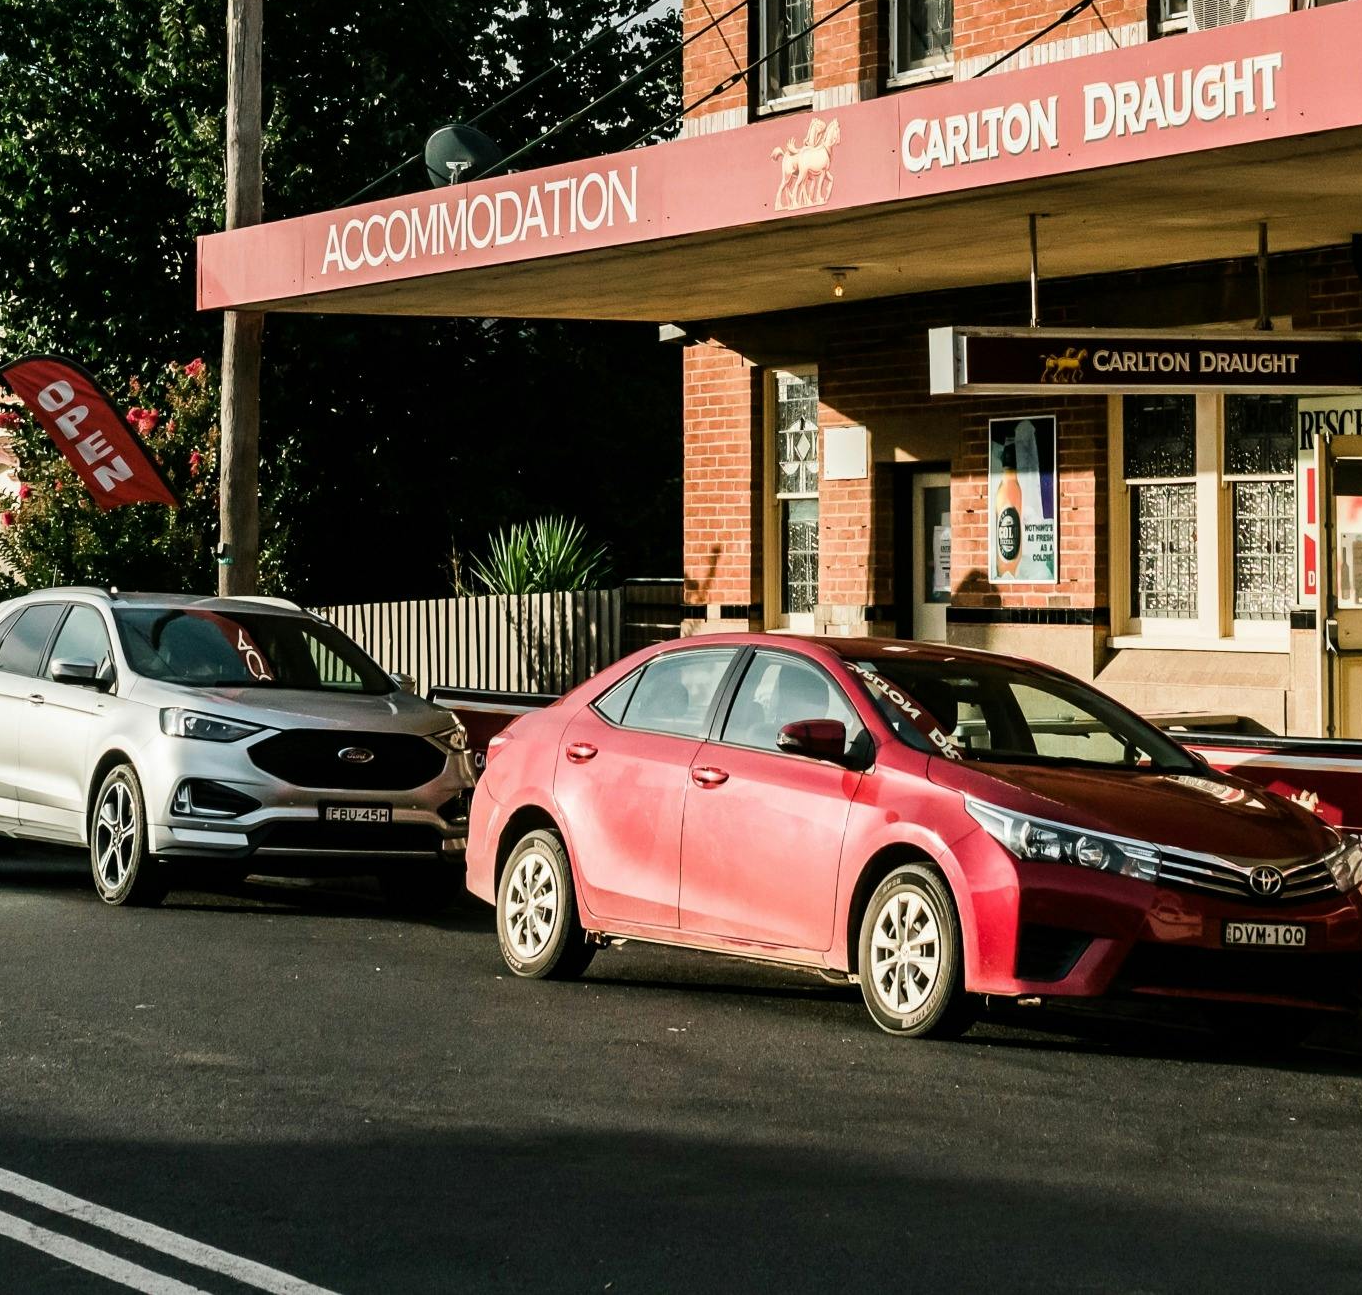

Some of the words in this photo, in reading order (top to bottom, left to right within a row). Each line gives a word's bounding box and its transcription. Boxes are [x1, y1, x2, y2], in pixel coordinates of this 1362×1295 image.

[900, 94, 1060, 176] CARLTON
[1082, 51, 1284, 144] DRAUGHT
[319, 165, 640, 276] ACCOMMODATION
[1092, 349, 1191, 374] CARLTON
[1199, 349, 1301, 375] DRAUGHT
[37, 378, 135, 493] OPEN
